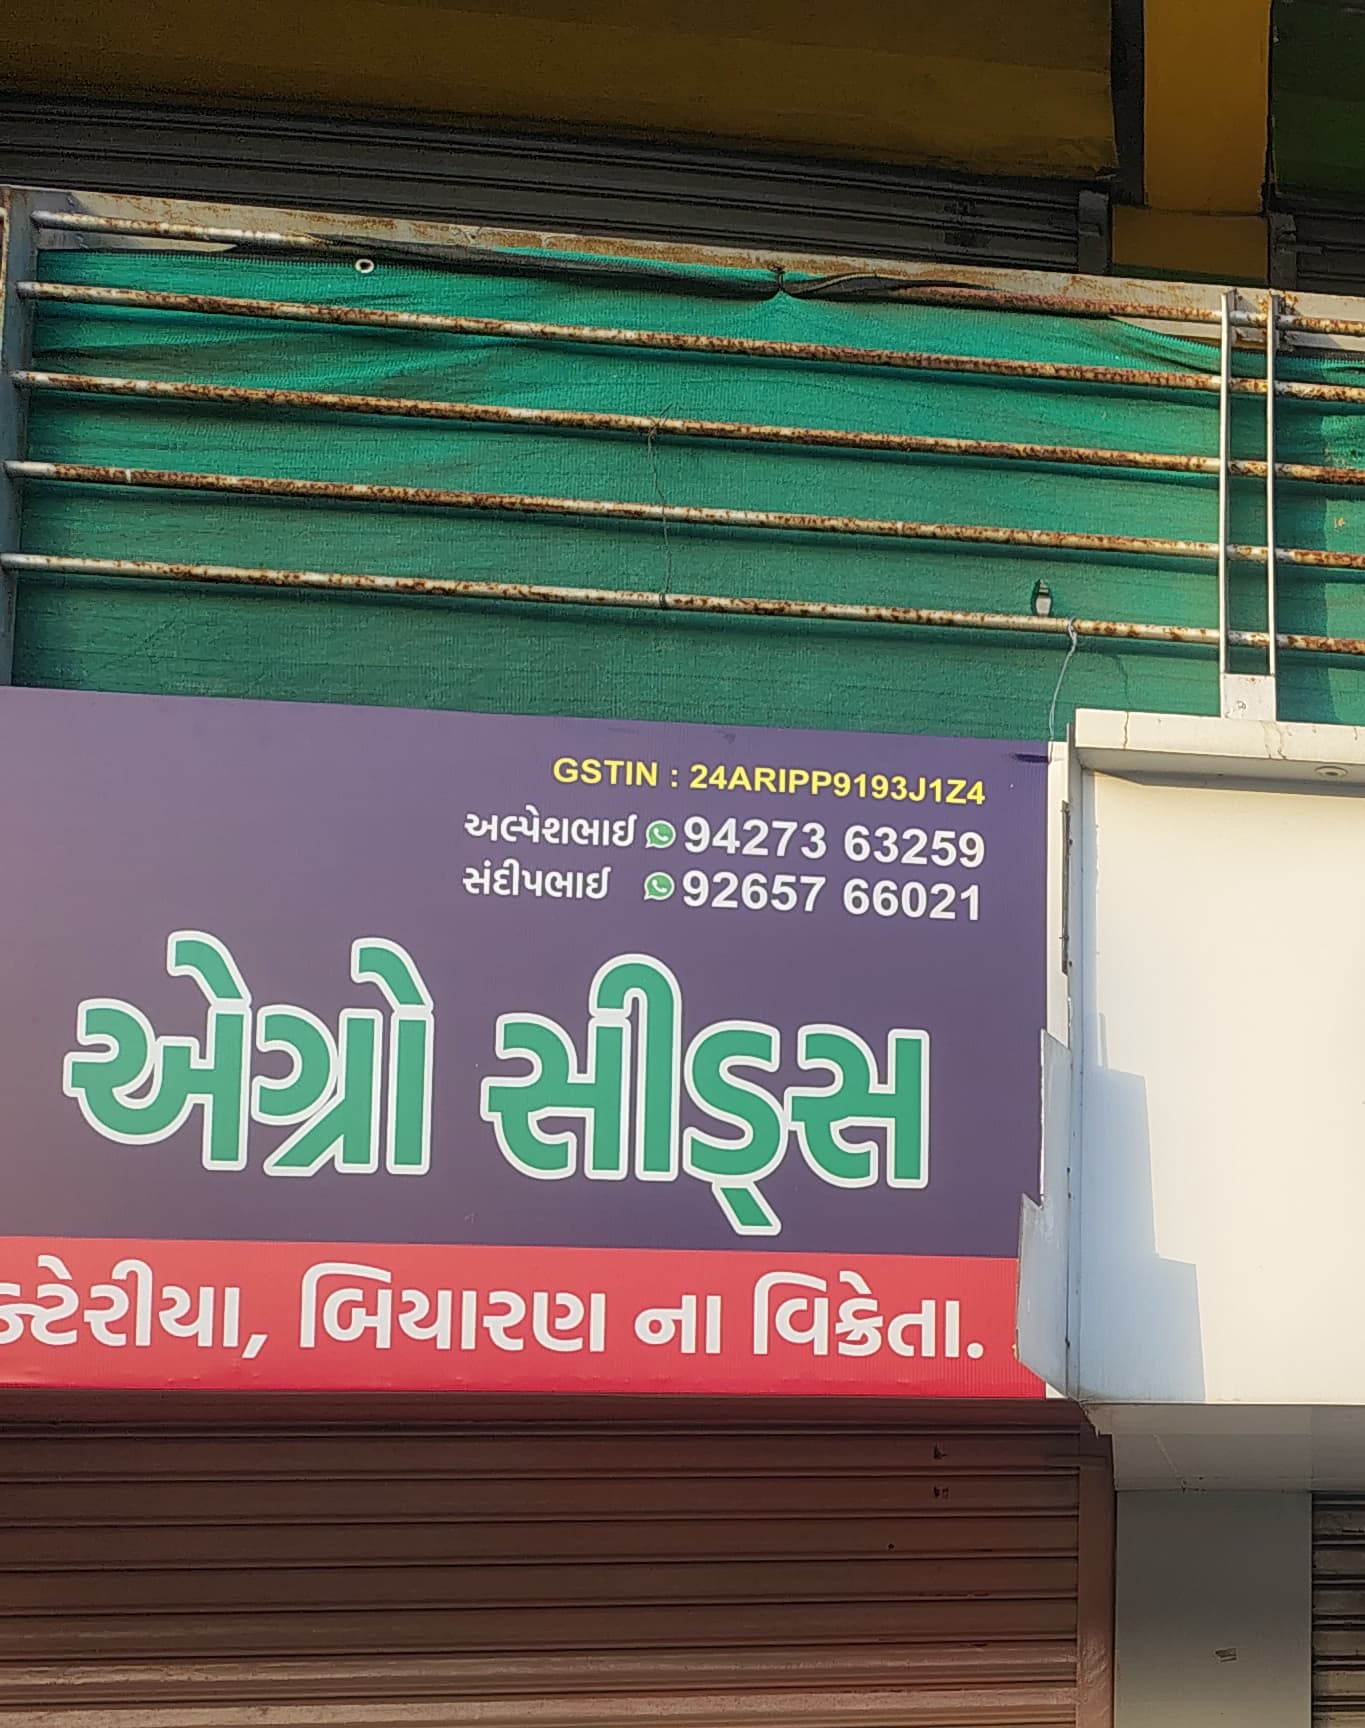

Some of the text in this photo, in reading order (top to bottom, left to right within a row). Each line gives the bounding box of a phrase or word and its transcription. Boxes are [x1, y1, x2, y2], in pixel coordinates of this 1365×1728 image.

[553, 757, 659, 788] GSTIN
[689, 763, 987, 806] 24ARIPP9193J1Z4
[463, 804, 986, 869] અલ્પેશભાઈ 94273 63259
[462, 858, 983, 922] સંદીપભાઈ 92657 66021
[63, 930, 931, 1236] એગ્રો સીડ્સ
[300, 1260, 607, 1356] બિયારણ
[634, 1289, 722, 1357] ના
